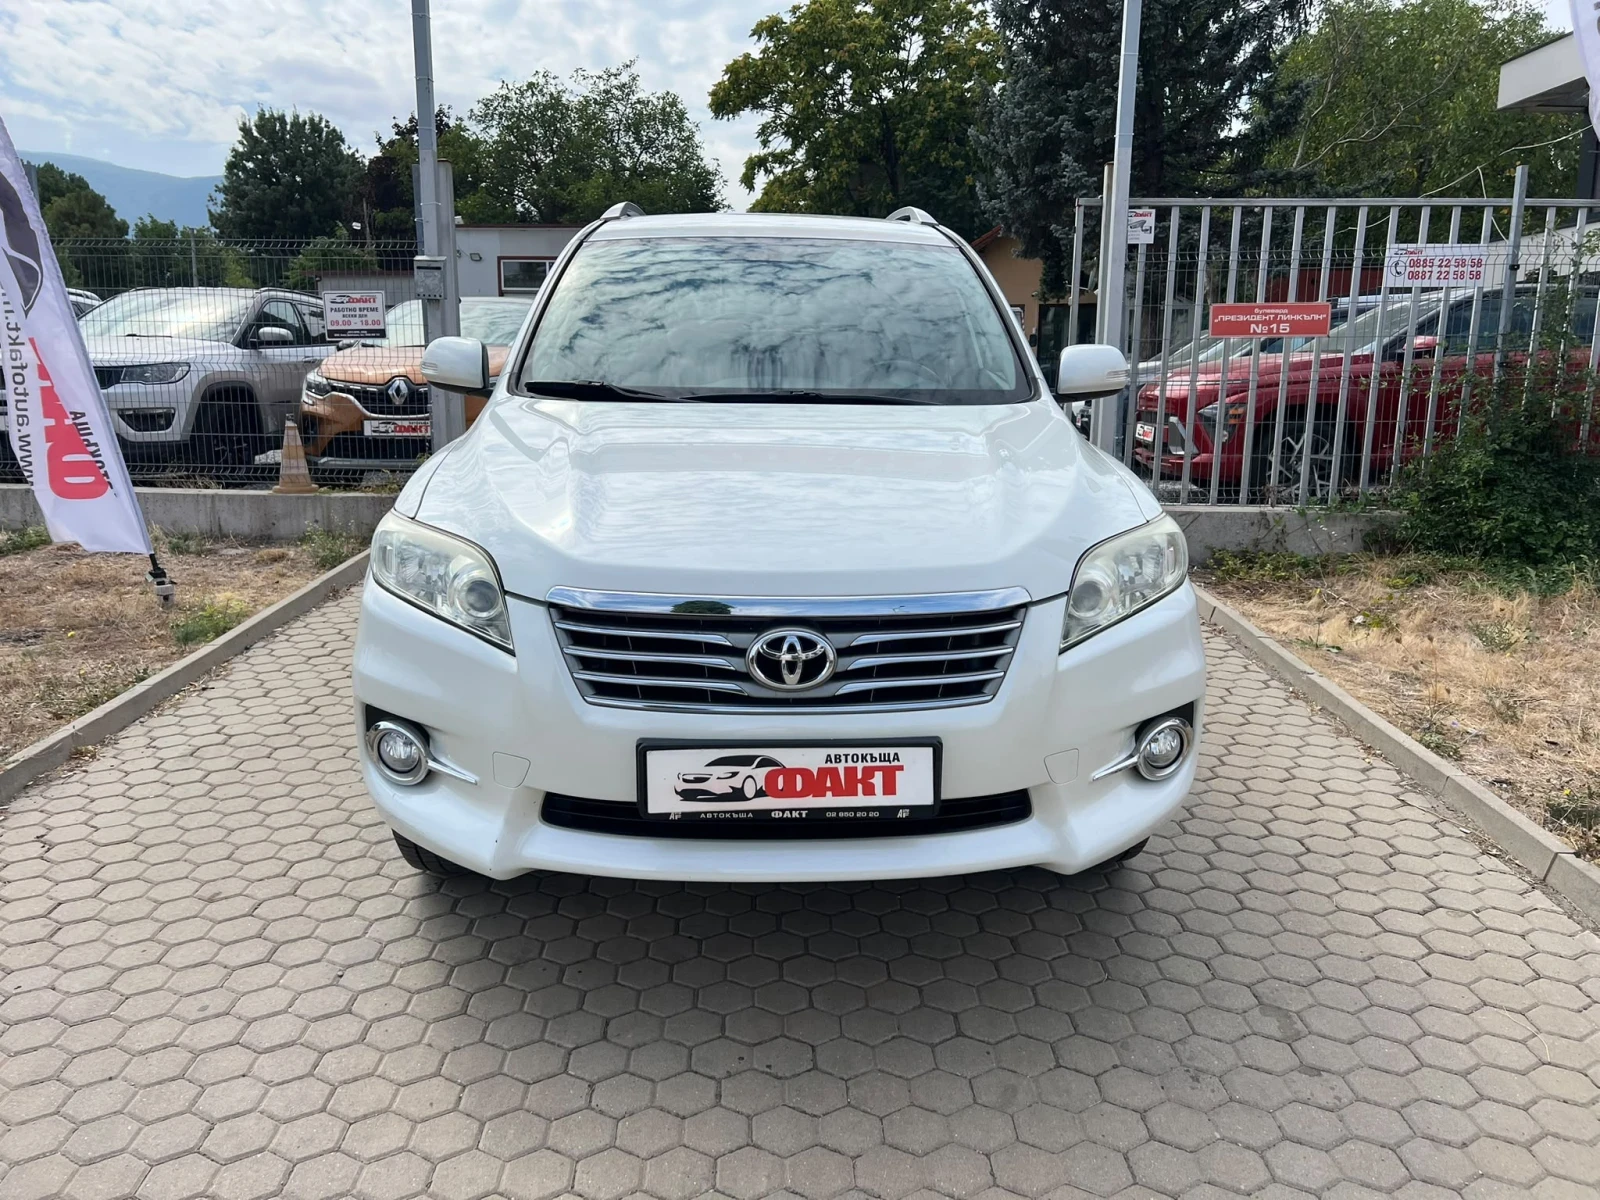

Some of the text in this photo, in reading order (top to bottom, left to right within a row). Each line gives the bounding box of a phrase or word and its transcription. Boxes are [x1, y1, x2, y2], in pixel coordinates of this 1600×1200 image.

[1409, 258, 1483, 268] 0885 22 58 58
[1407, 270, 1482, 280] 0887 22 58 58
[825, 752, 901, 764] АВТОКЪЩА
[764, 764, 904, 799] ФАКТ
[771, 810, 808, 818] ФАКТ
